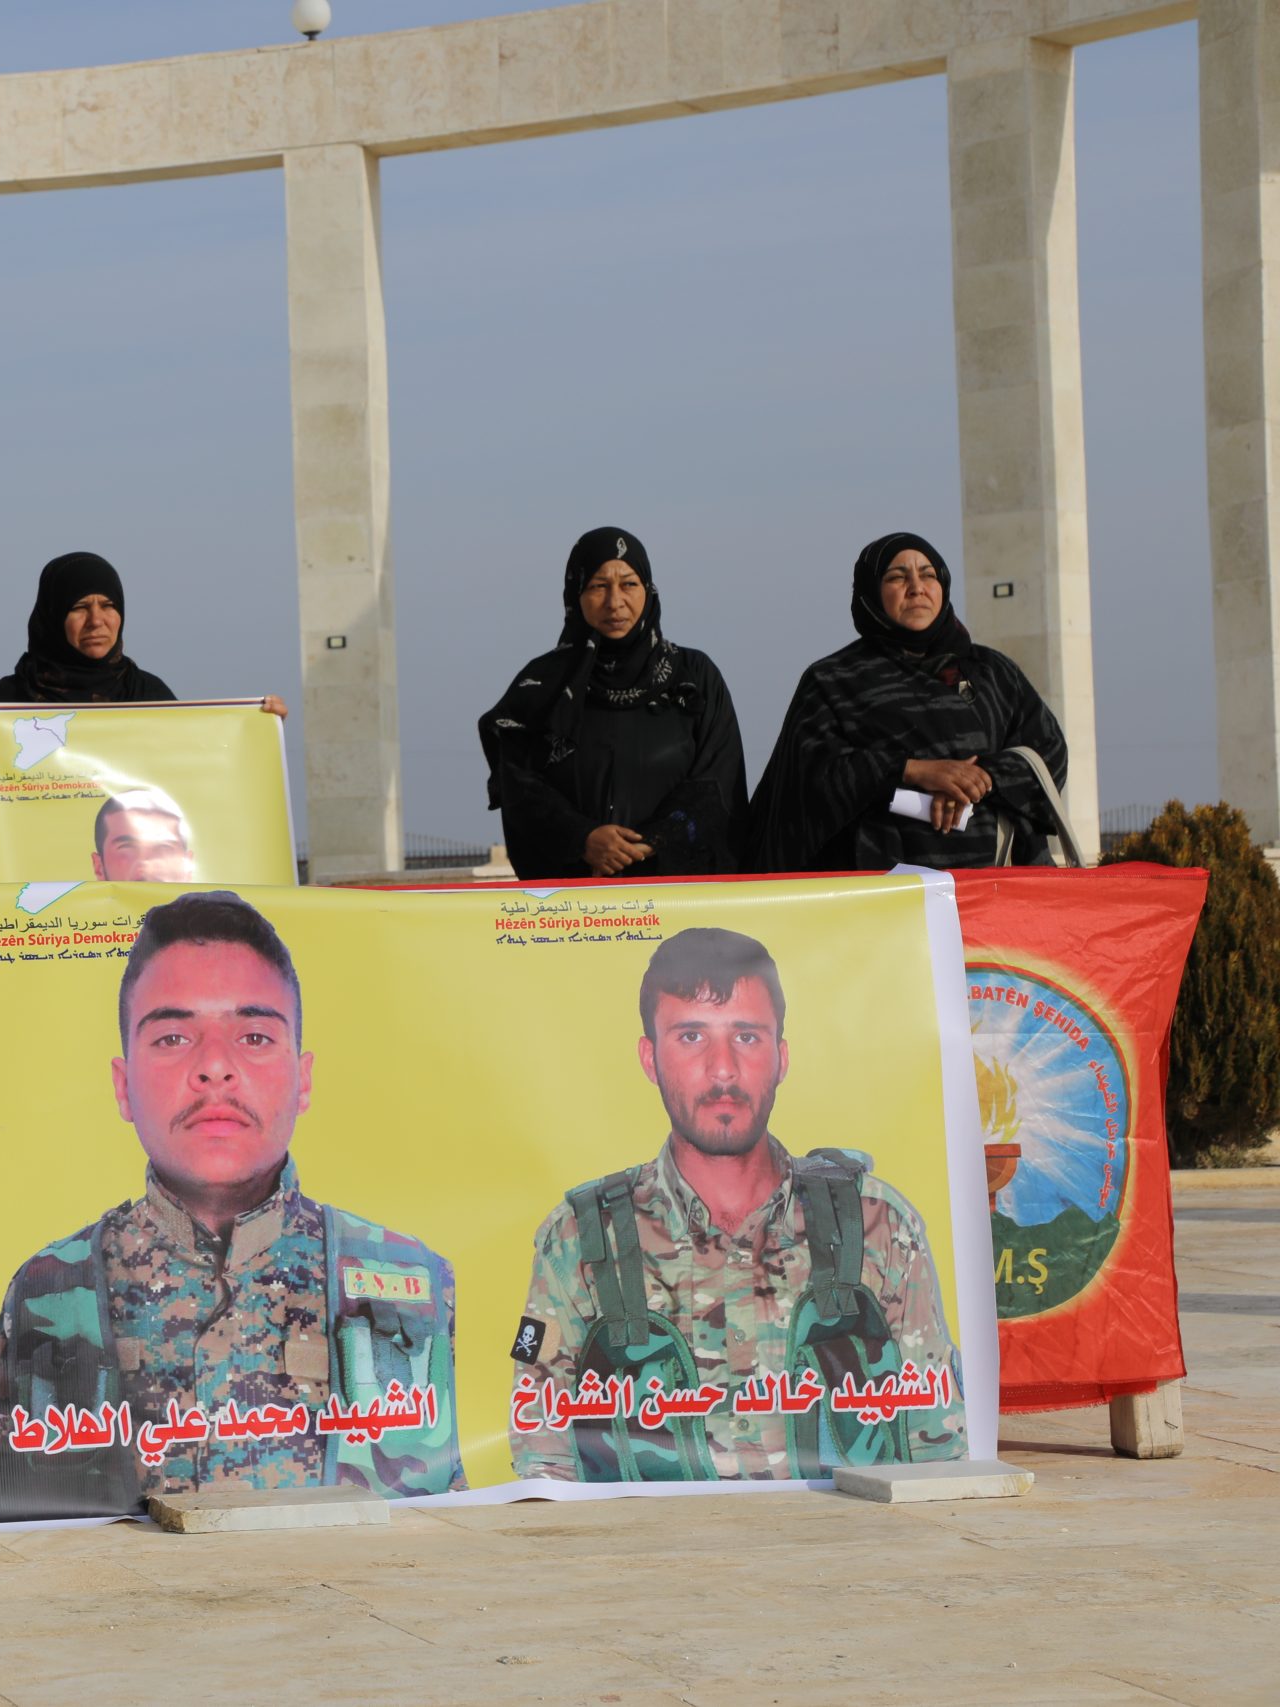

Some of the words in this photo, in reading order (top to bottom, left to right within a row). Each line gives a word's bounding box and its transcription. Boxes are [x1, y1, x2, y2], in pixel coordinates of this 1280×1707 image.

[22, 782, 50, 792] Sûriya
[495, 916, 536, 930] Hêzên
[539, 915, 580, 931] Sûriya
[583, 913, 660, 929] Demokratîk
[500, 900, 572, 916] الديمقراطية
[577, 900, 617, 914] سوريا
[621, 898, 655, 913] قوات
[28, 932, 70, 948] Sûriya
[68, 916, 108, 931] سوريا
[967, 985, 1029, 1009] BATÊN
[510, 1369, 633, 1433] الشواخ
[640, 1374, 726, 1428] حسن
[734, 1367, 825, 1415] خالد
[831, 1360, 951, 1425] الشهيد
[10, 1399, 131, 1455] الهلاط
[217, 1397, 308, 1441] محمد
[317, 1379, 438, 1444] الشهيد
[137, 1396, 209, 1467] علي
